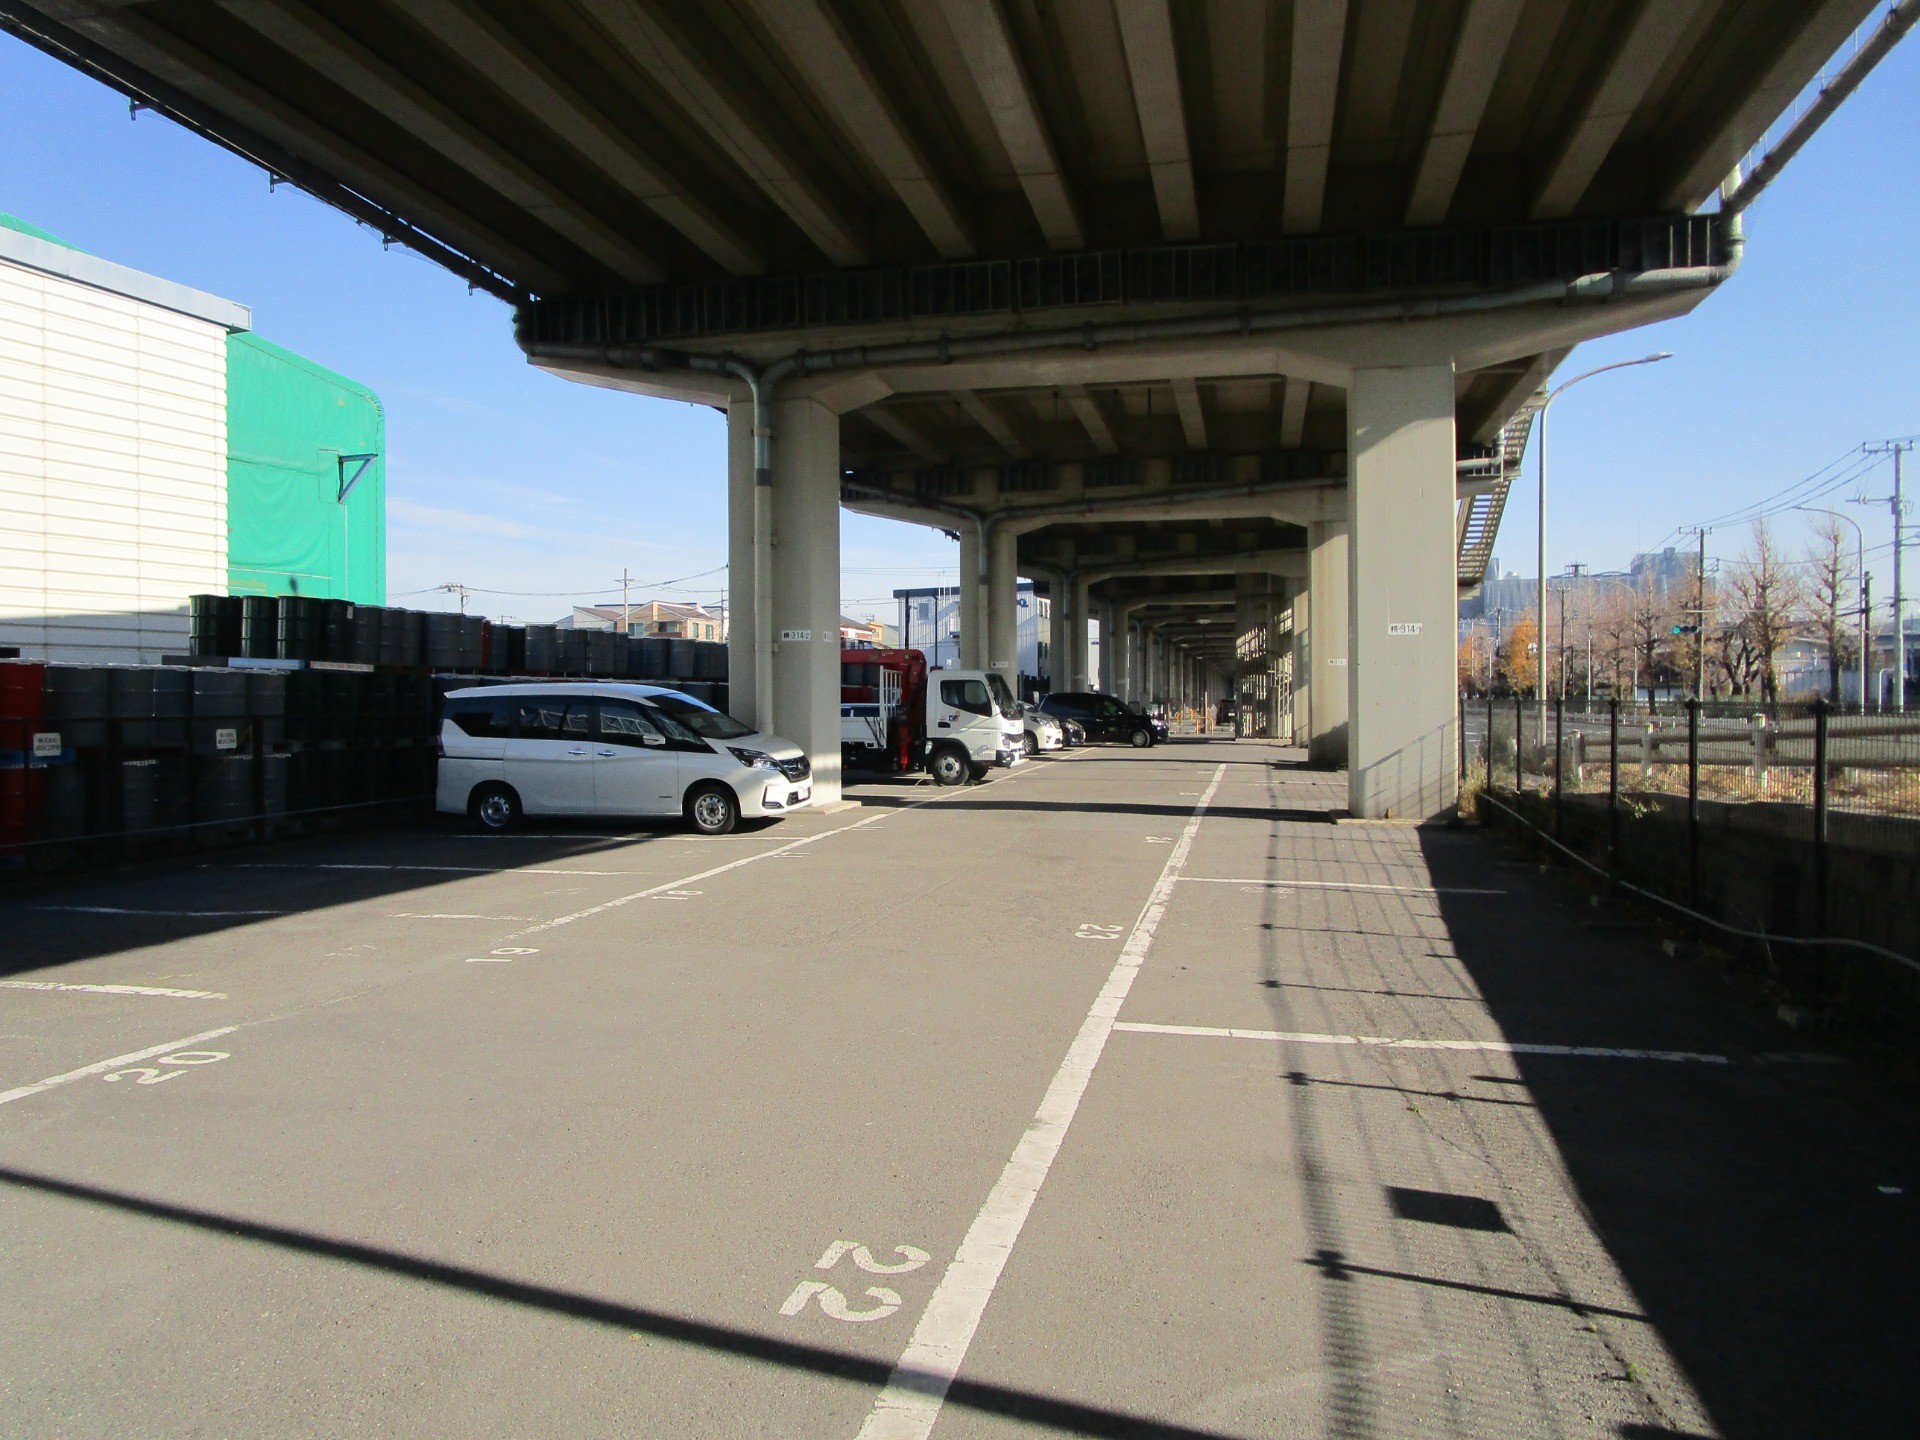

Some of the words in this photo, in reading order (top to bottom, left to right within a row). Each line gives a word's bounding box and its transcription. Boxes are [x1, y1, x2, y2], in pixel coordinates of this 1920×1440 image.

[1074, 923, 1124, 940] 23
[464, 945, 541, 964] 19
[102, 1050, 232, 1086] 20
[778, 1239, 932, 1323] 22
